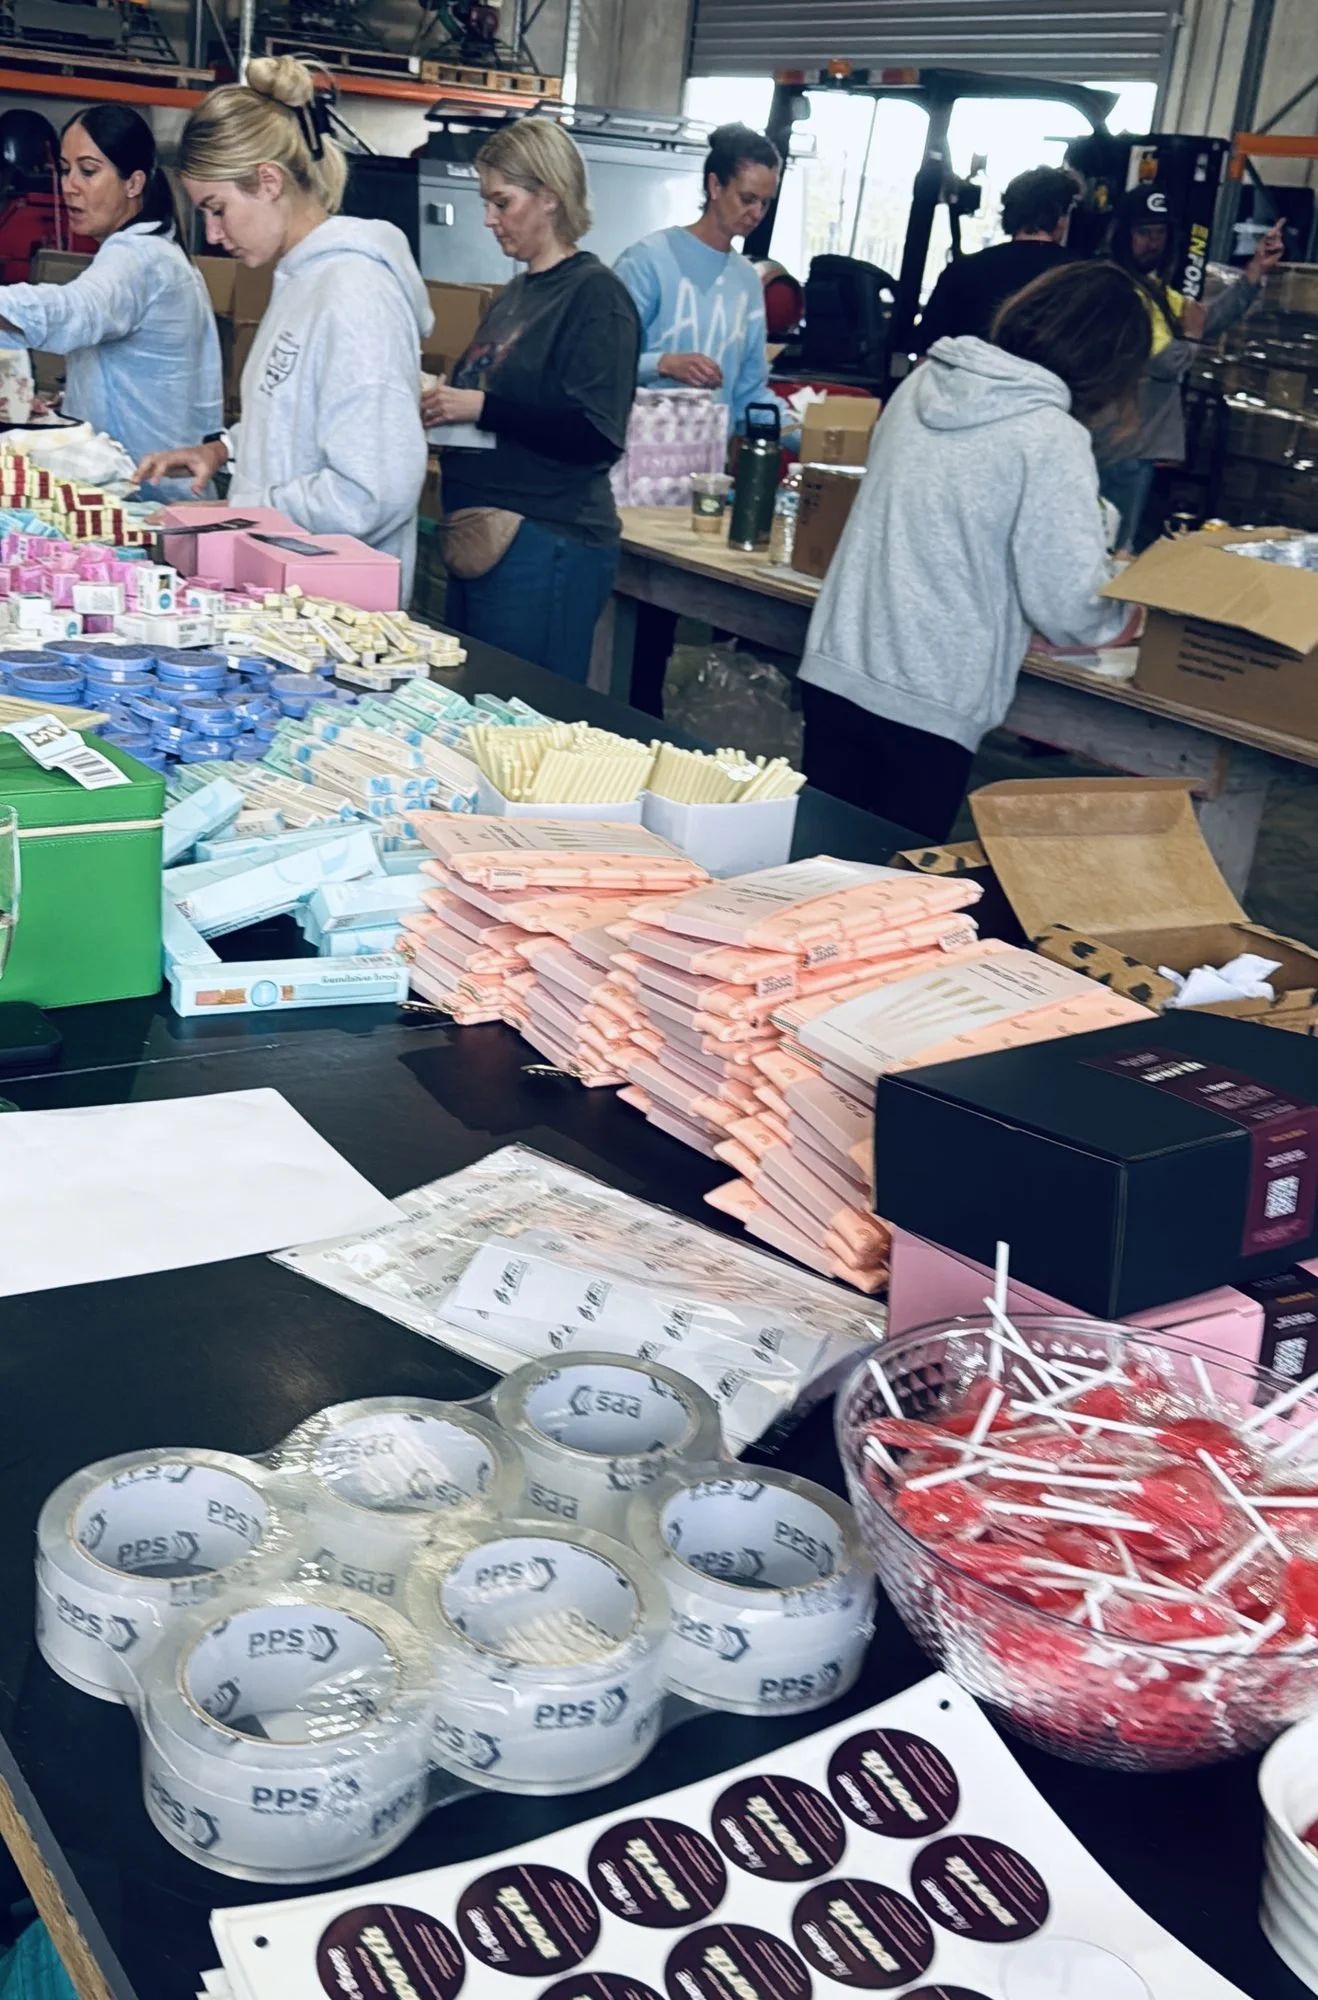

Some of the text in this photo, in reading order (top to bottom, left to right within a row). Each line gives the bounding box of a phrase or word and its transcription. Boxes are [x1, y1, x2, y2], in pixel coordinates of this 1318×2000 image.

[1181, 223, 1209, 299] ENFOR
[207, 1500, 249, 1532] PPS
[117, 1536, 168, 1567] PPS
[774, 1520, 818, 1557] PPS
[475, 1562, 525, 1588] PPS
[57, 1594, 102, 1634] PPS
[249, 1628, 304, 1651] PPS
[761, 1674, 815, 1698] PPS
[536, 1699, 596, 1727] PPS
[253, 1785, 319, 1810] PPS
